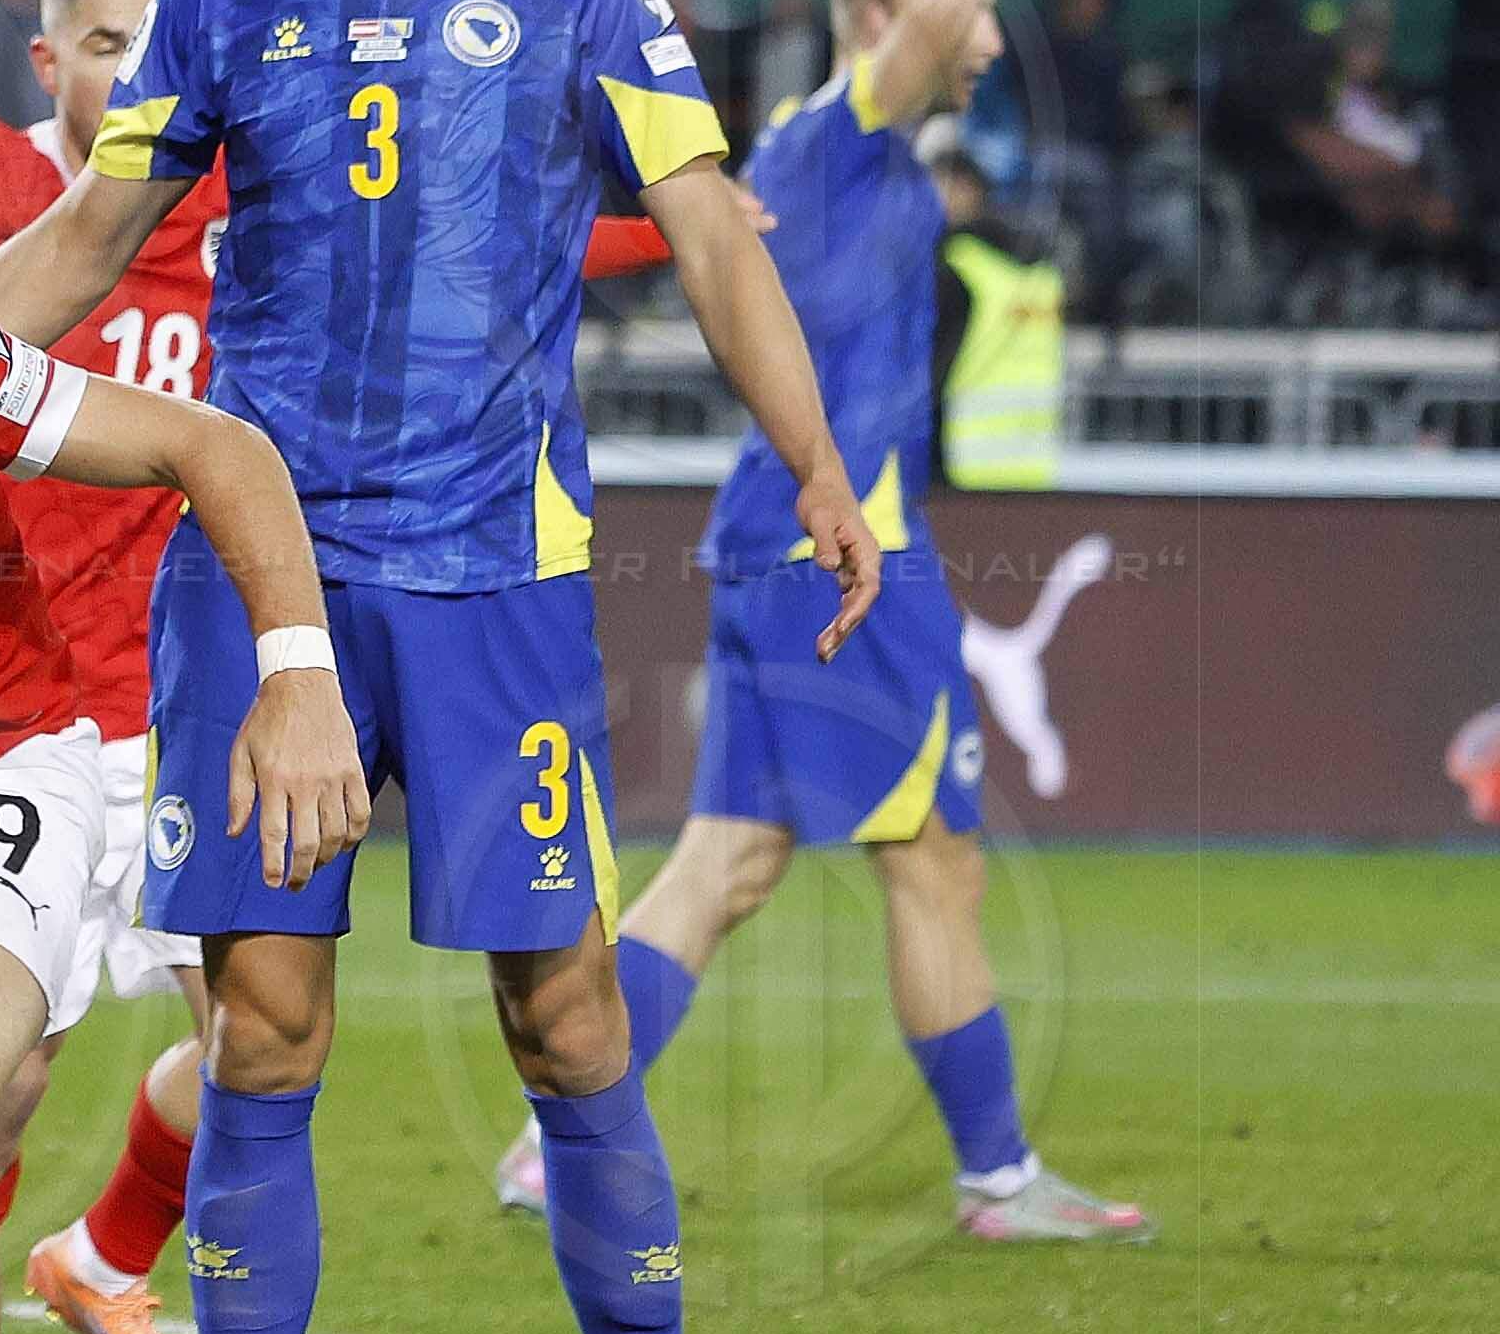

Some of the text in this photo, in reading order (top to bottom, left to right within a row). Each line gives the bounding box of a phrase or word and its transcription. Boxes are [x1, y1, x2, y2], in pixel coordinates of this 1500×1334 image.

[347, 83, 400, 200] 3
[100, 306, 202, 402] 18
[518, 721, 571, 839] 3
